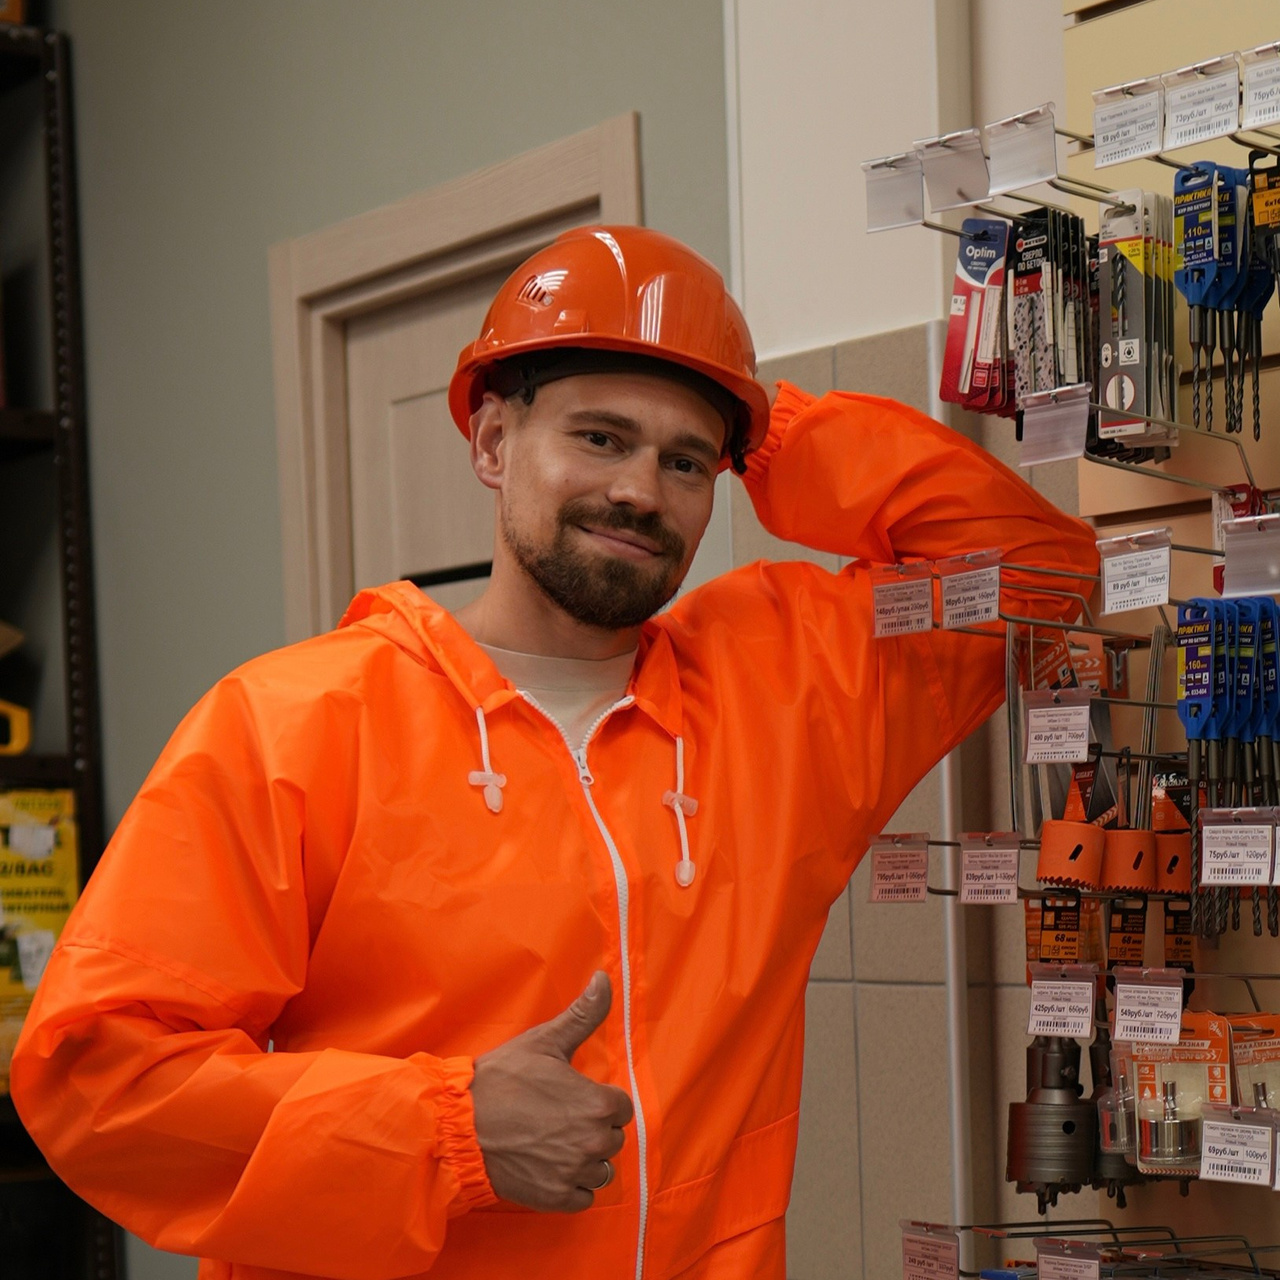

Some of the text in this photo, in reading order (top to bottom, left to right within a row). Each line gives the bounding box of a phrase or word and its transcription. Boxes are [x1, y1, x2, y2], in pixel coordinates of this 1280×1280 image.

[966, 246, 996, 259] Optim
[1022, 249, 1043, 259] СВЕРЛО
[1018, 261, 1027, 271] ПО
[1113, 583, 1119, 591] 89
[1178, 623, 1210, 634] ПРАКТИКА
[1075, 770, 1094, 780] GIGANT
[1209, 850, 1240, 859] 75руб./шт
[1055, 934, 1066, 942] 68
[1122, 936, 1131, 945] 68
[1175, 937, 1182, 945] 68
[1034, 1004, 1065, 1012] 425руб./шт
[1120, 1008, 1153, 1018] 549руб./шт
[1207, 1145, 1239, 1157] 69руб./шт
